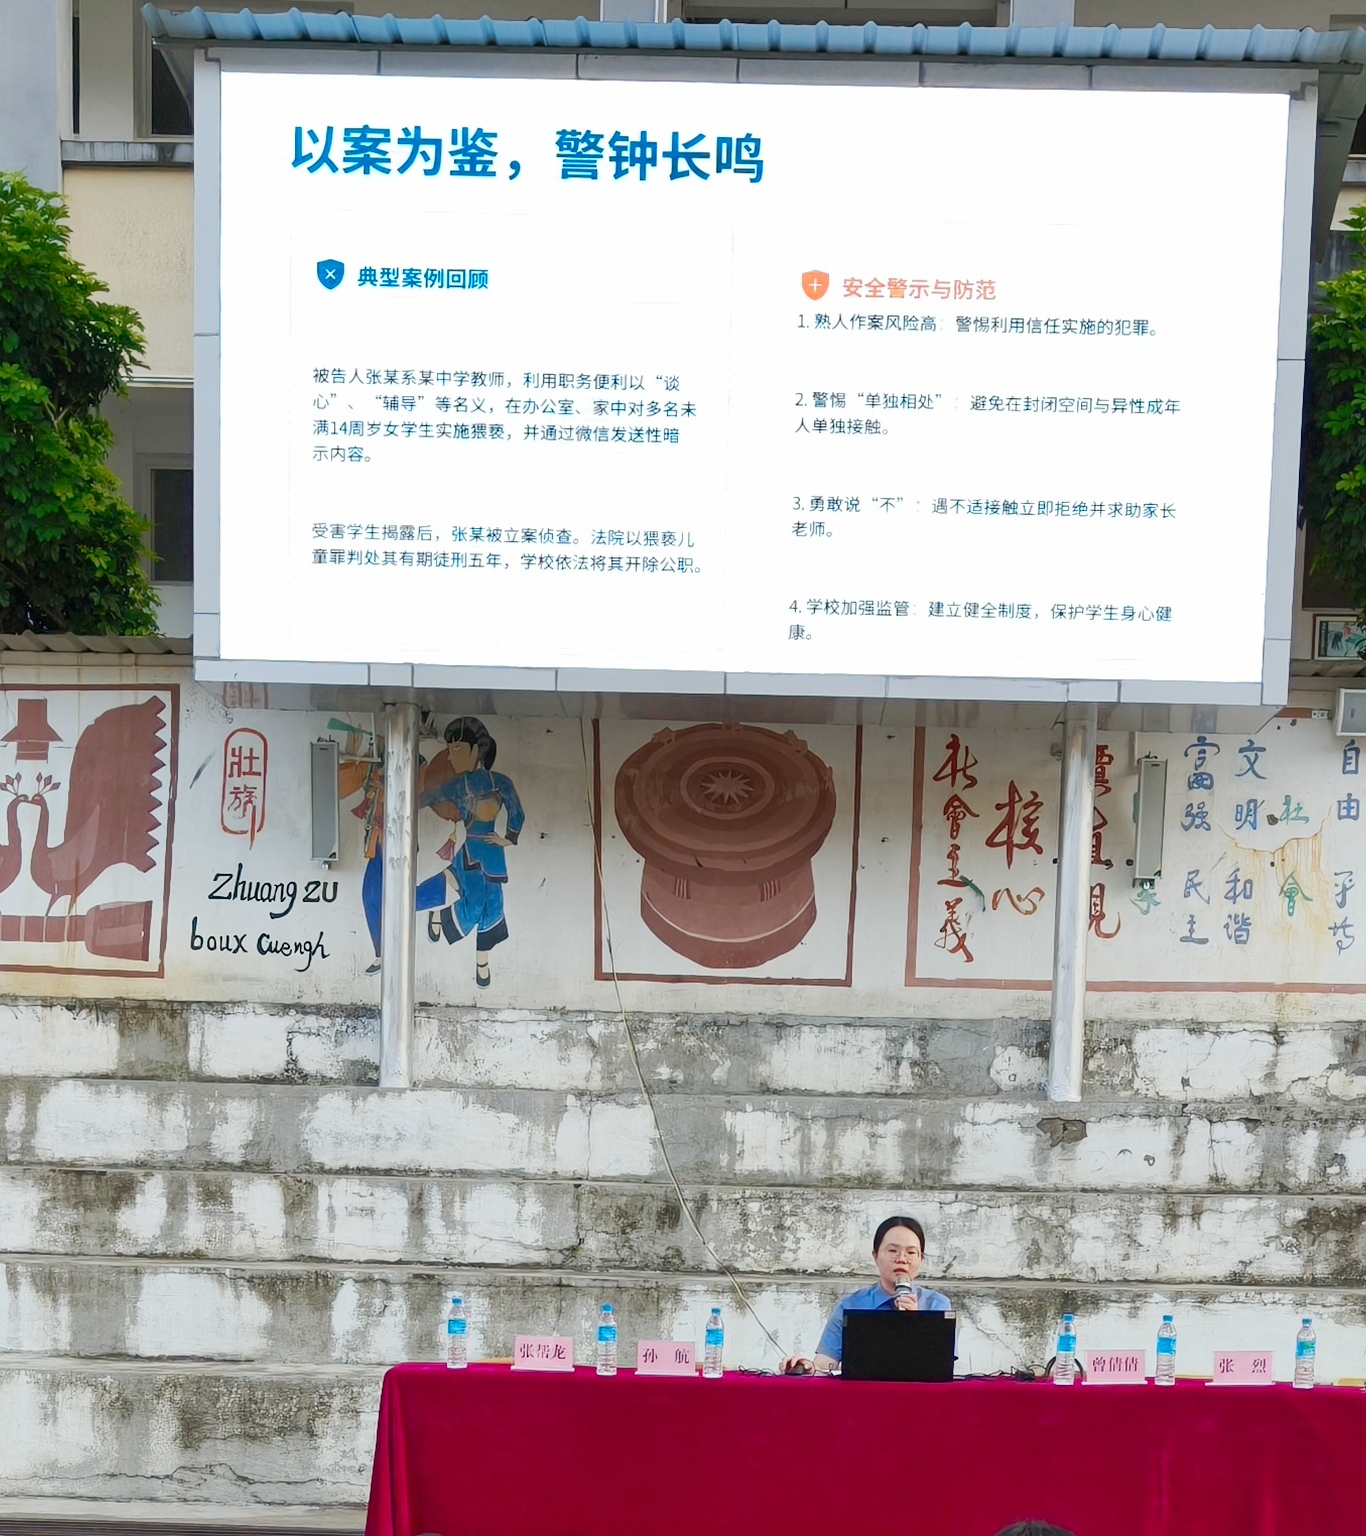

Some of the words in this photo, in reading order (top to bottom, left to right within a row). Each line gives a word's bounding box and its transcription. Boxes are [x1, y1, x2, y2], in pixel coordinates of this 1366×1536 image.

[291, 124, 765, 184] 以案为鉴，警钟长鸣
[357, 265, 490, 291] 典型案例回顾
[843, 277, 997, 301] 安全警示与防范
[795, 416, 888, 435] 人单独接触。
[312, 445, 371, 463] 示内容。
[791, 520, 832, 538] 老师。
[788, 624, 812, 641] 康。
[985, 779, 1045, 916] 核心
[207, 862, 297, 920] Zhuang
[190, 916, 248, 954] boux
